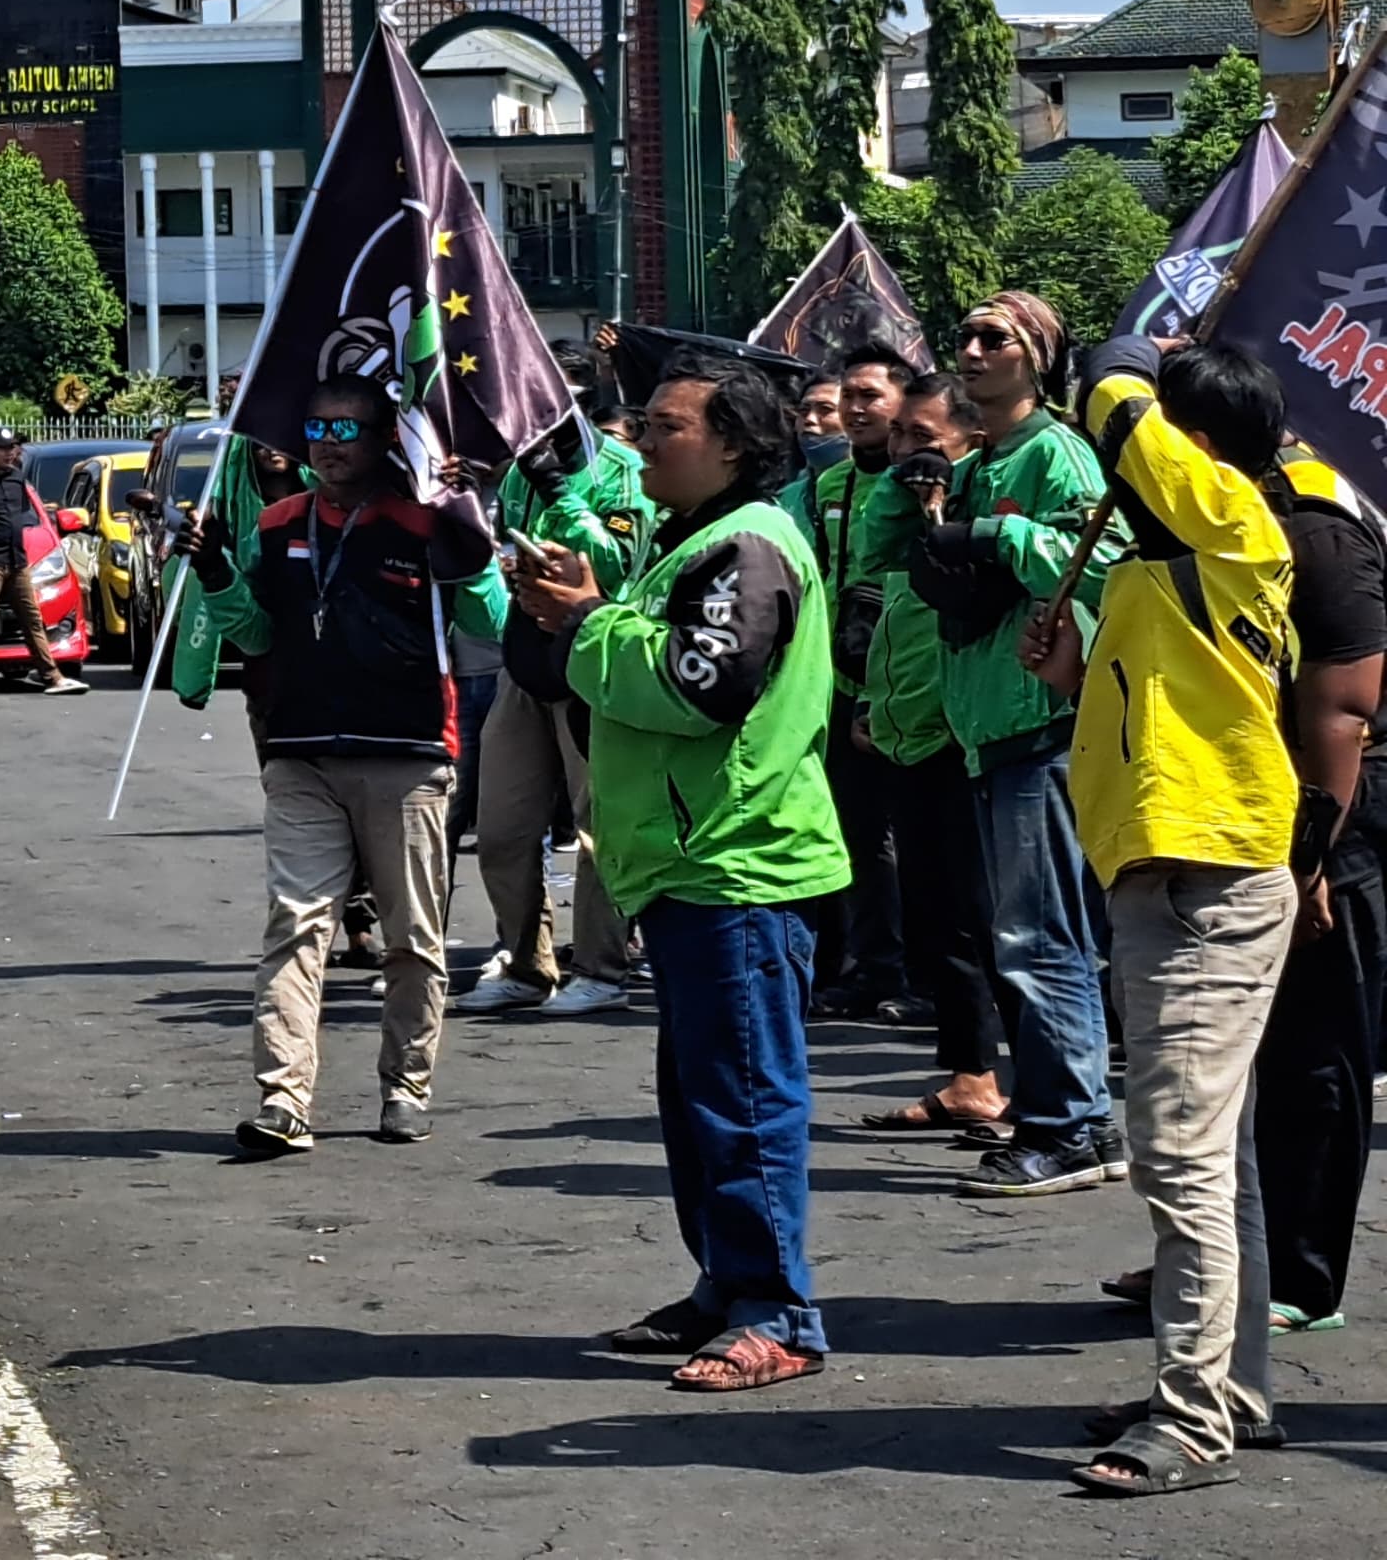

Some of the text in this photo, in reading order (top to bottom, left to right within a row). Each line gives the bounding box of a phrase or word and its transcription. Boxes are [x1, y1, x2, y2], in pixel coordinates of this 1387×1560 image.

[12, 100, 38, 114] DAY
[42, 98, 99, 114] SCHOOL
[679, 570, 740, 691] gojek
